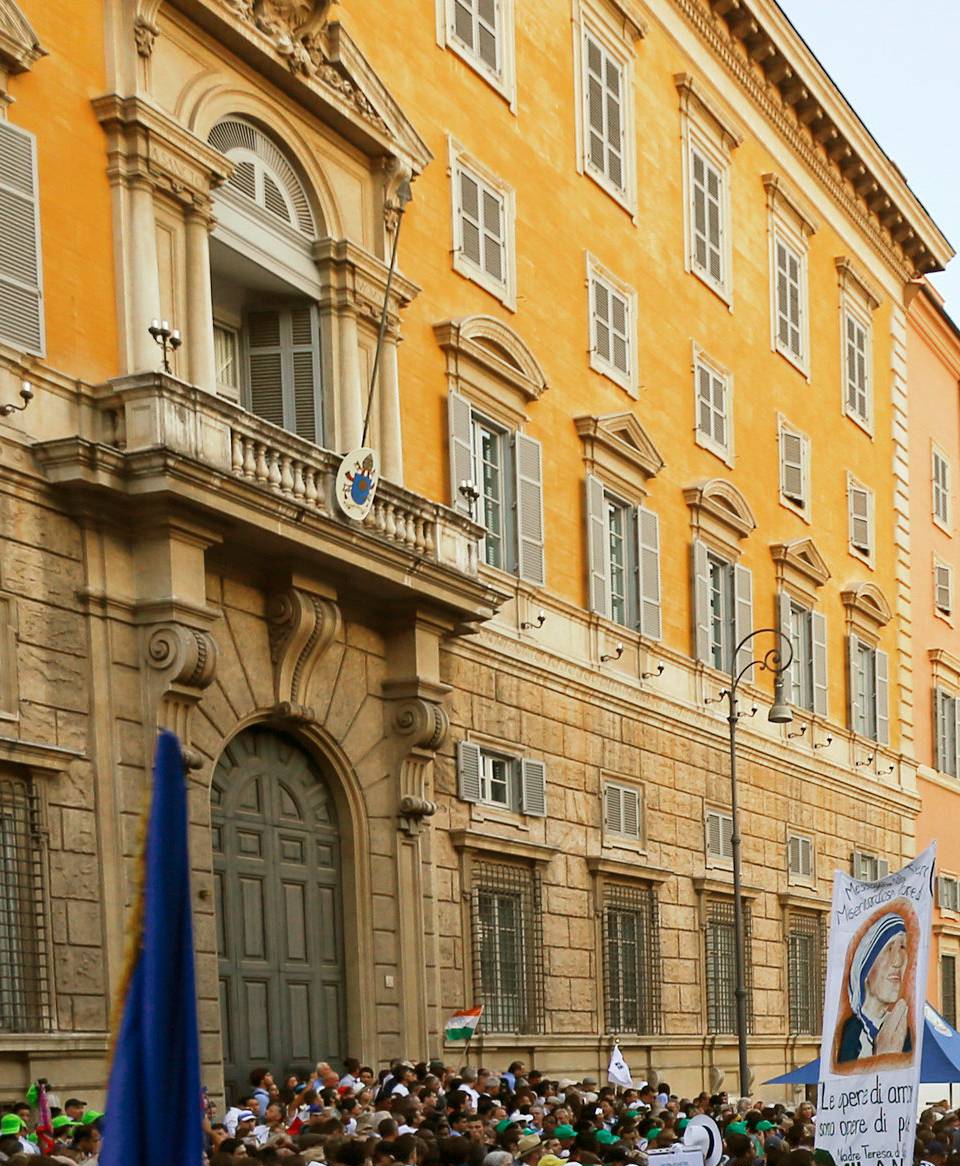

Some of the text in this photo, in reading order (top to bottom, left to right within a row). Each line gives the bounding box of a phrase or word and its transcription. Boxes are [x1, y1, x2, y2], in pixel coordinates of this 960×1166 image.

[821, 1081, 835, 1110] Le
[870, 1075, 883, 1104] di
[874, 1106, 887, 1133] di
[861, 1144, 893, 1159] Teresa
